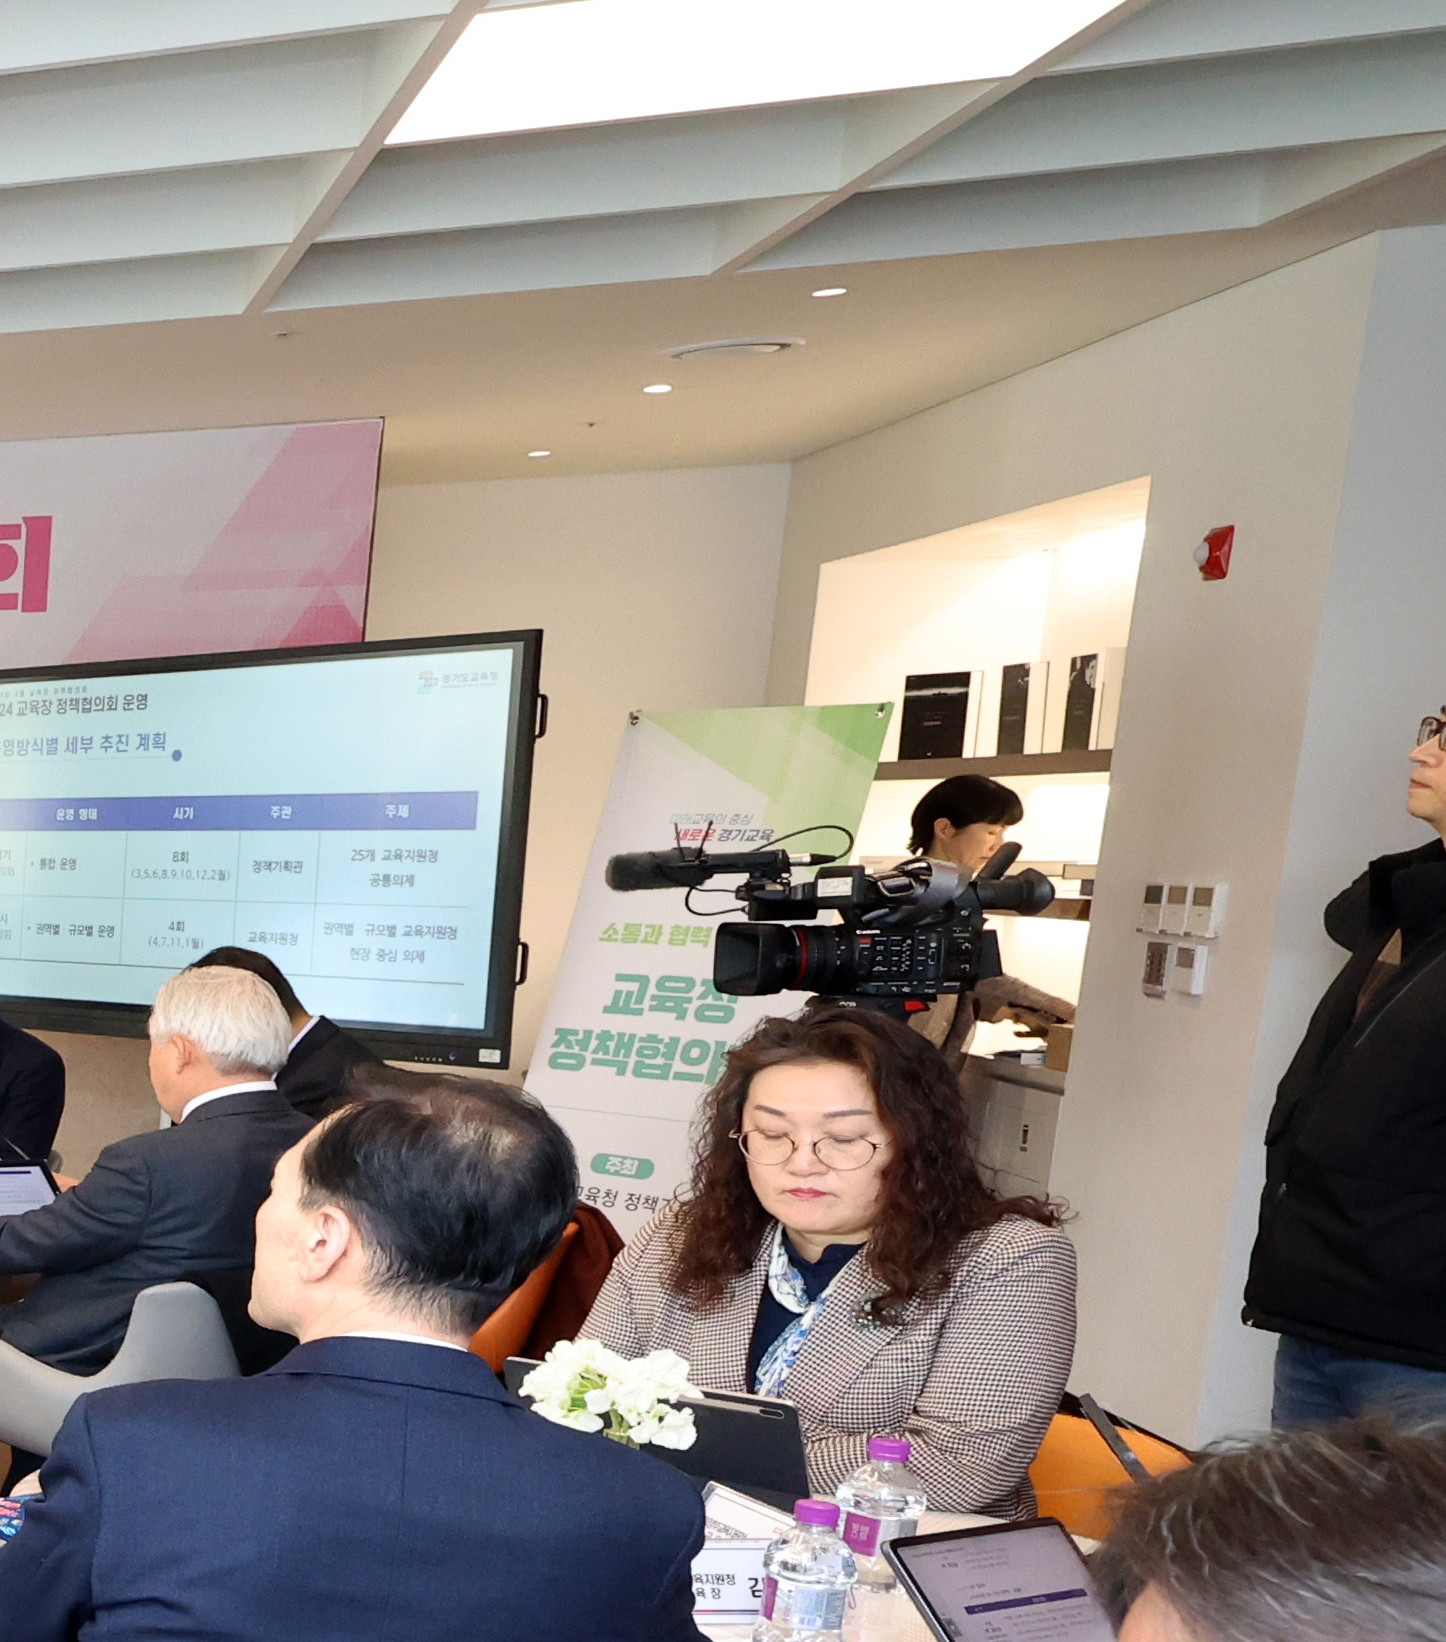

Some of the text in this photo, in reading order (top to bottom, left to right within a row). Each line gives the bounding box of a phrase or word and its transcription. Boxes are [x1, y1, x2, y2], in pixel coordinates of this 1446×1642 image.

[16, 700, 53, 716] 교육장
[56, 695, 119, 714] 정책협의회
[122, 693, 149, 711] 운영
[64, 735, 94, 755] 세부
[99, 733, 130, 754] 추진
[136, 731, 167, 752] 계획
[717, 828, 775, 842] 경기교육
[350, 849, 439, 863] 25개 교육지원청
[599, 923, 714, 948] 소통과 협력
[602, 973, 739, 1024] 교육장
[604, 1156, 640, 1176] 주최
[624, 1192, 674, 1215] 정책
